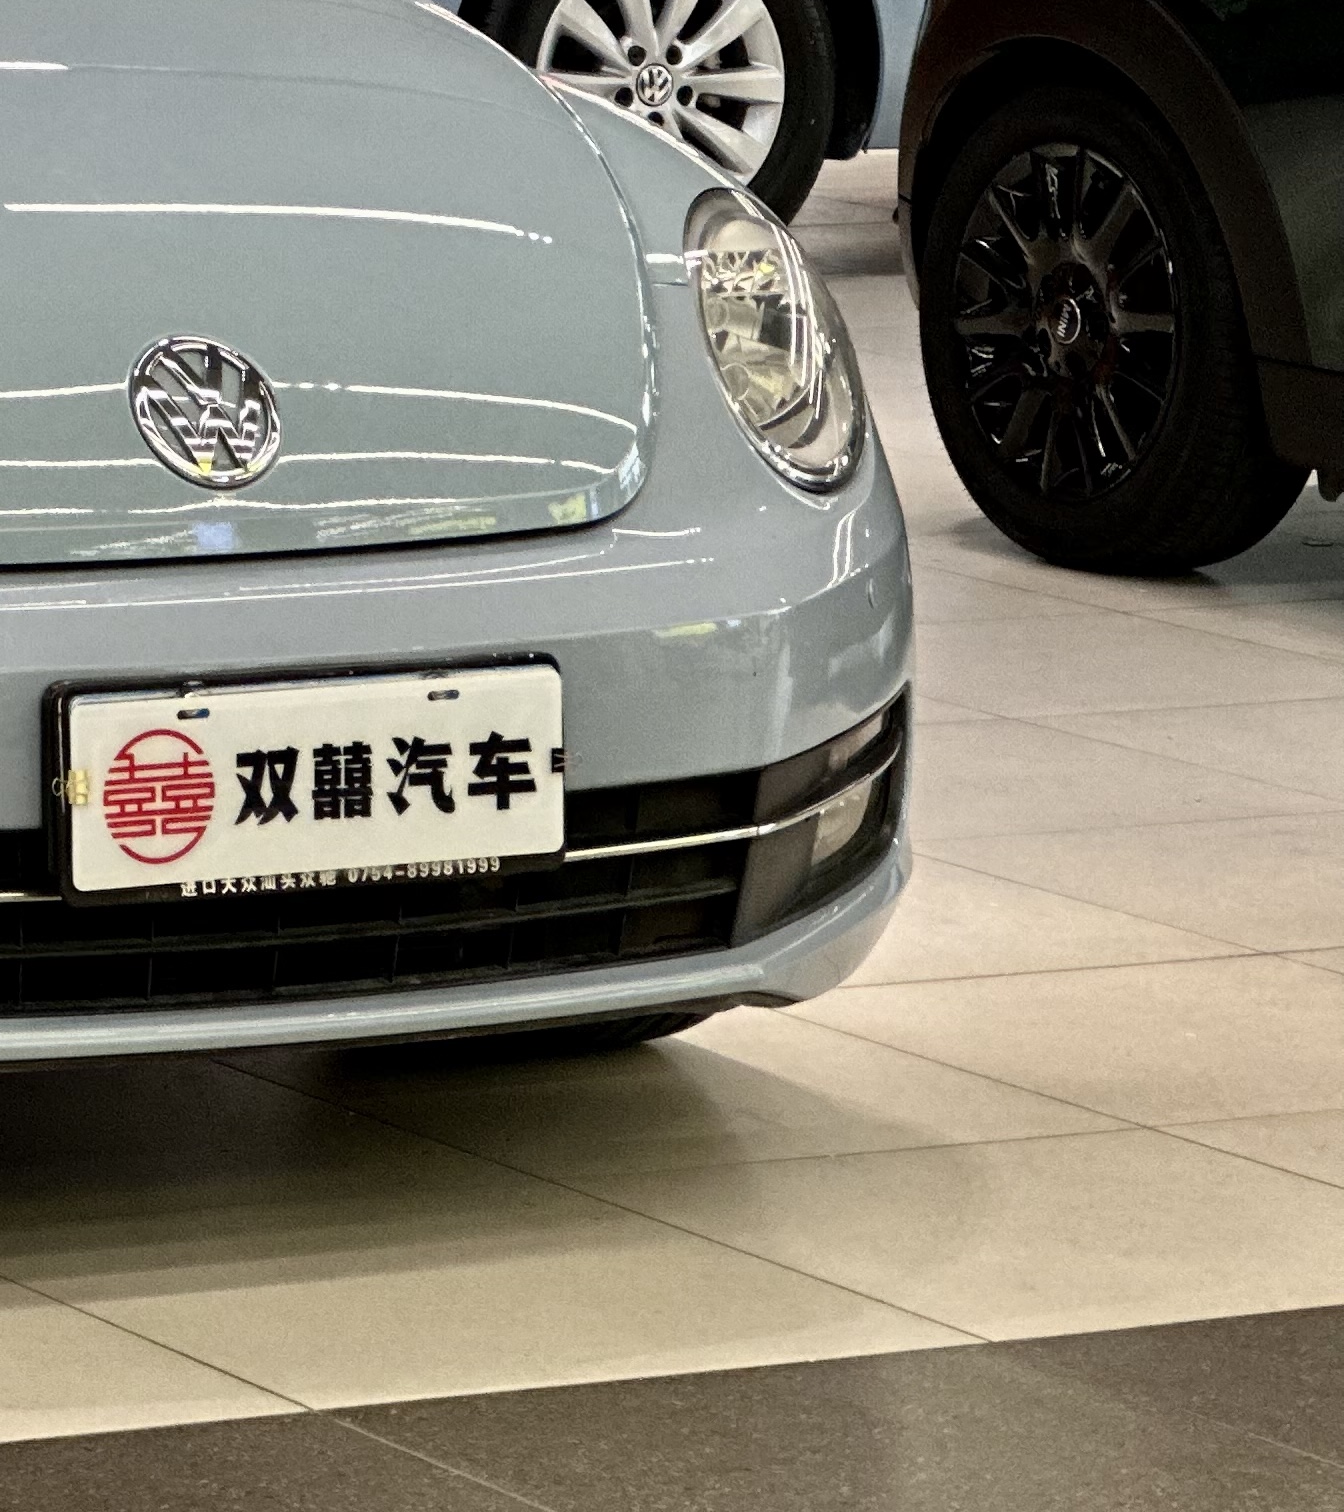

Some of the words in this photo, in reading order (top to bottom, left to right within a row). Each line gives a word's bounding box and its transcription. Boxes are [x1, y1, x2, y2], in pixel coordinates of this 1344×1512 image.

[234, 731, 537, 826] 双囍汽车
[347, 855, 500, 883] 0754-89981999
